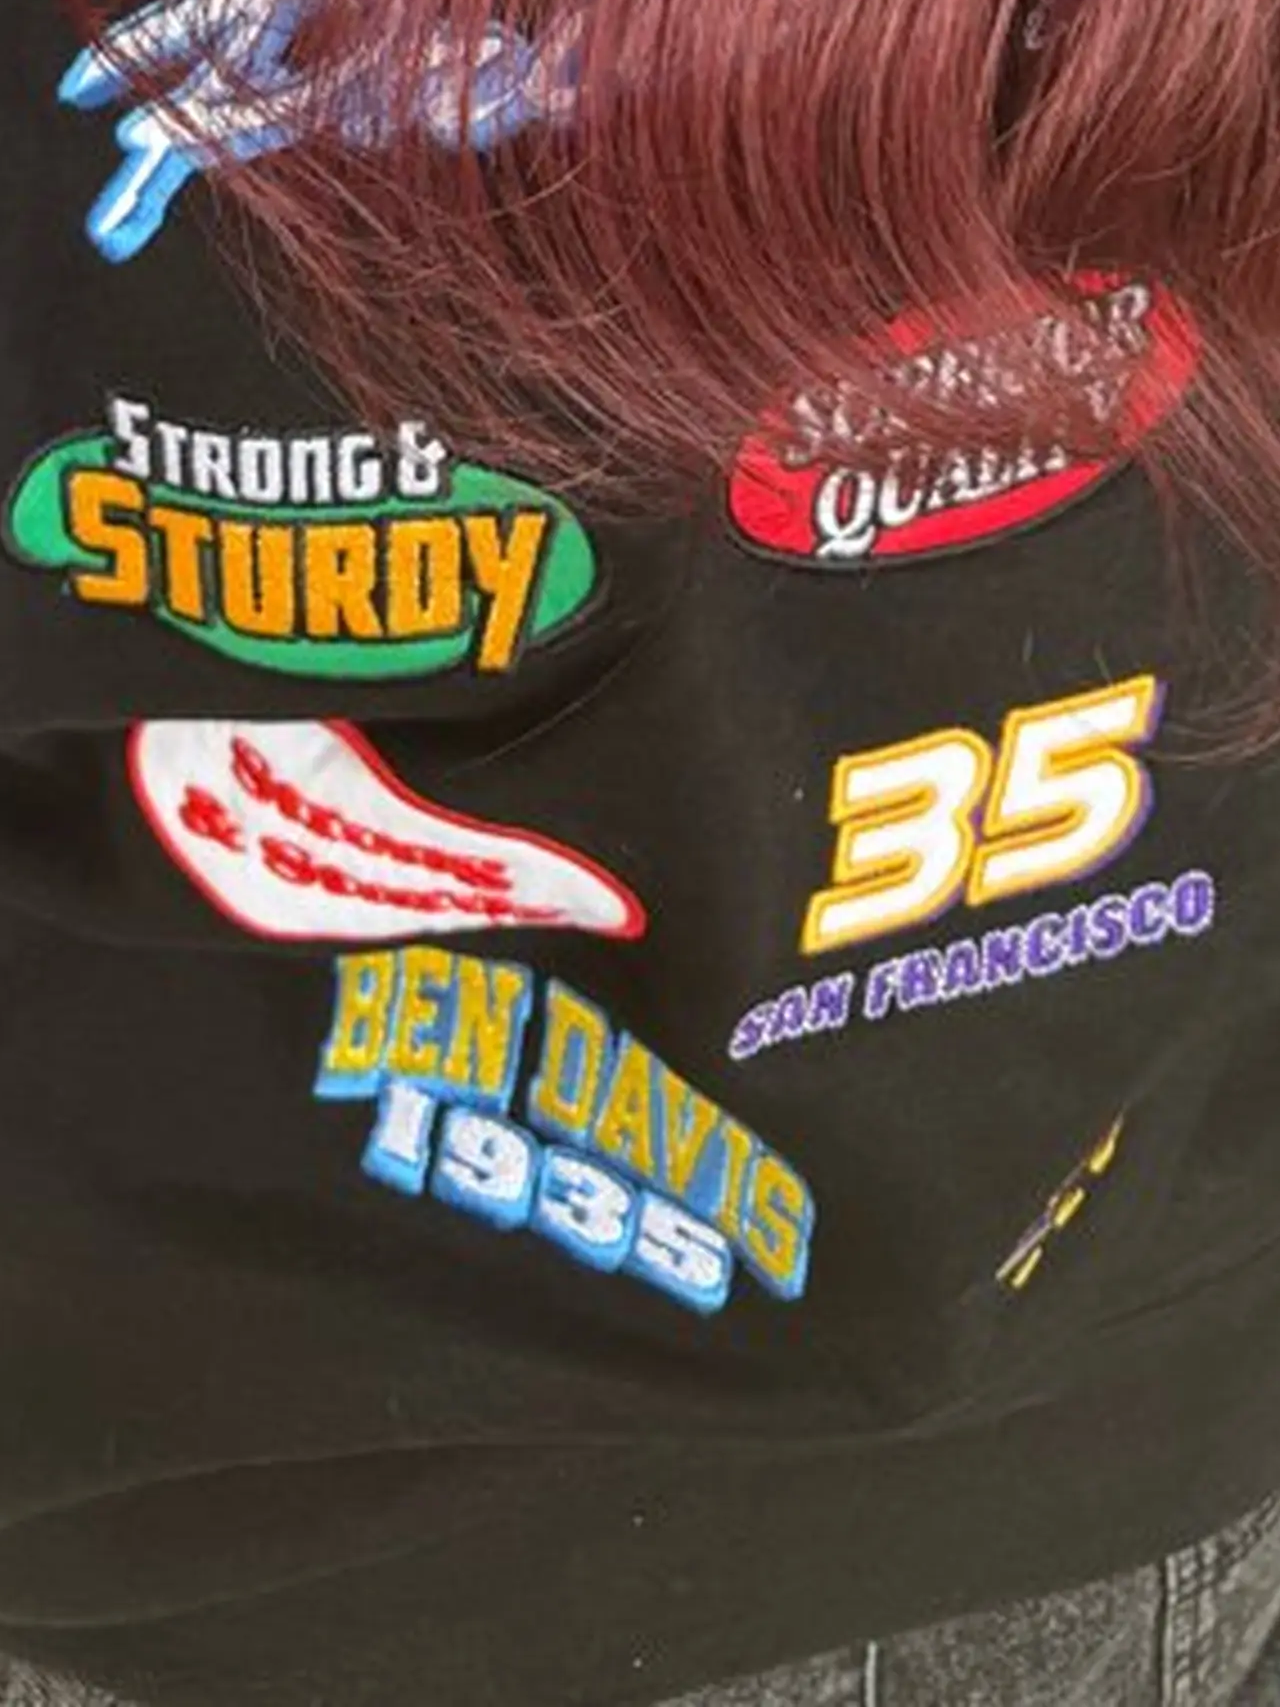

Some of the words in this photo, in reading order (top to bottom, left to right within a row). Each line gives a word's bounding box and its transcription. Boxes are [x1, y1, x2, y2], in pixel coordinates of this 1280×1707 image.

[111, 397, 384, 505] STRONG
[397, 419, 448, 498] &
[67, 469, 548, 674] STURDY
[800, 673, 1160, 957] 35
[728, 971, 856, 1062] SAN
[863, 869, 1218, 1019] FRANCISCO
[317, 945, 532, 1105] BEN
[532, 983, 812, 1293] DAVIS
[368, 1080, 731, 1303] 1935
